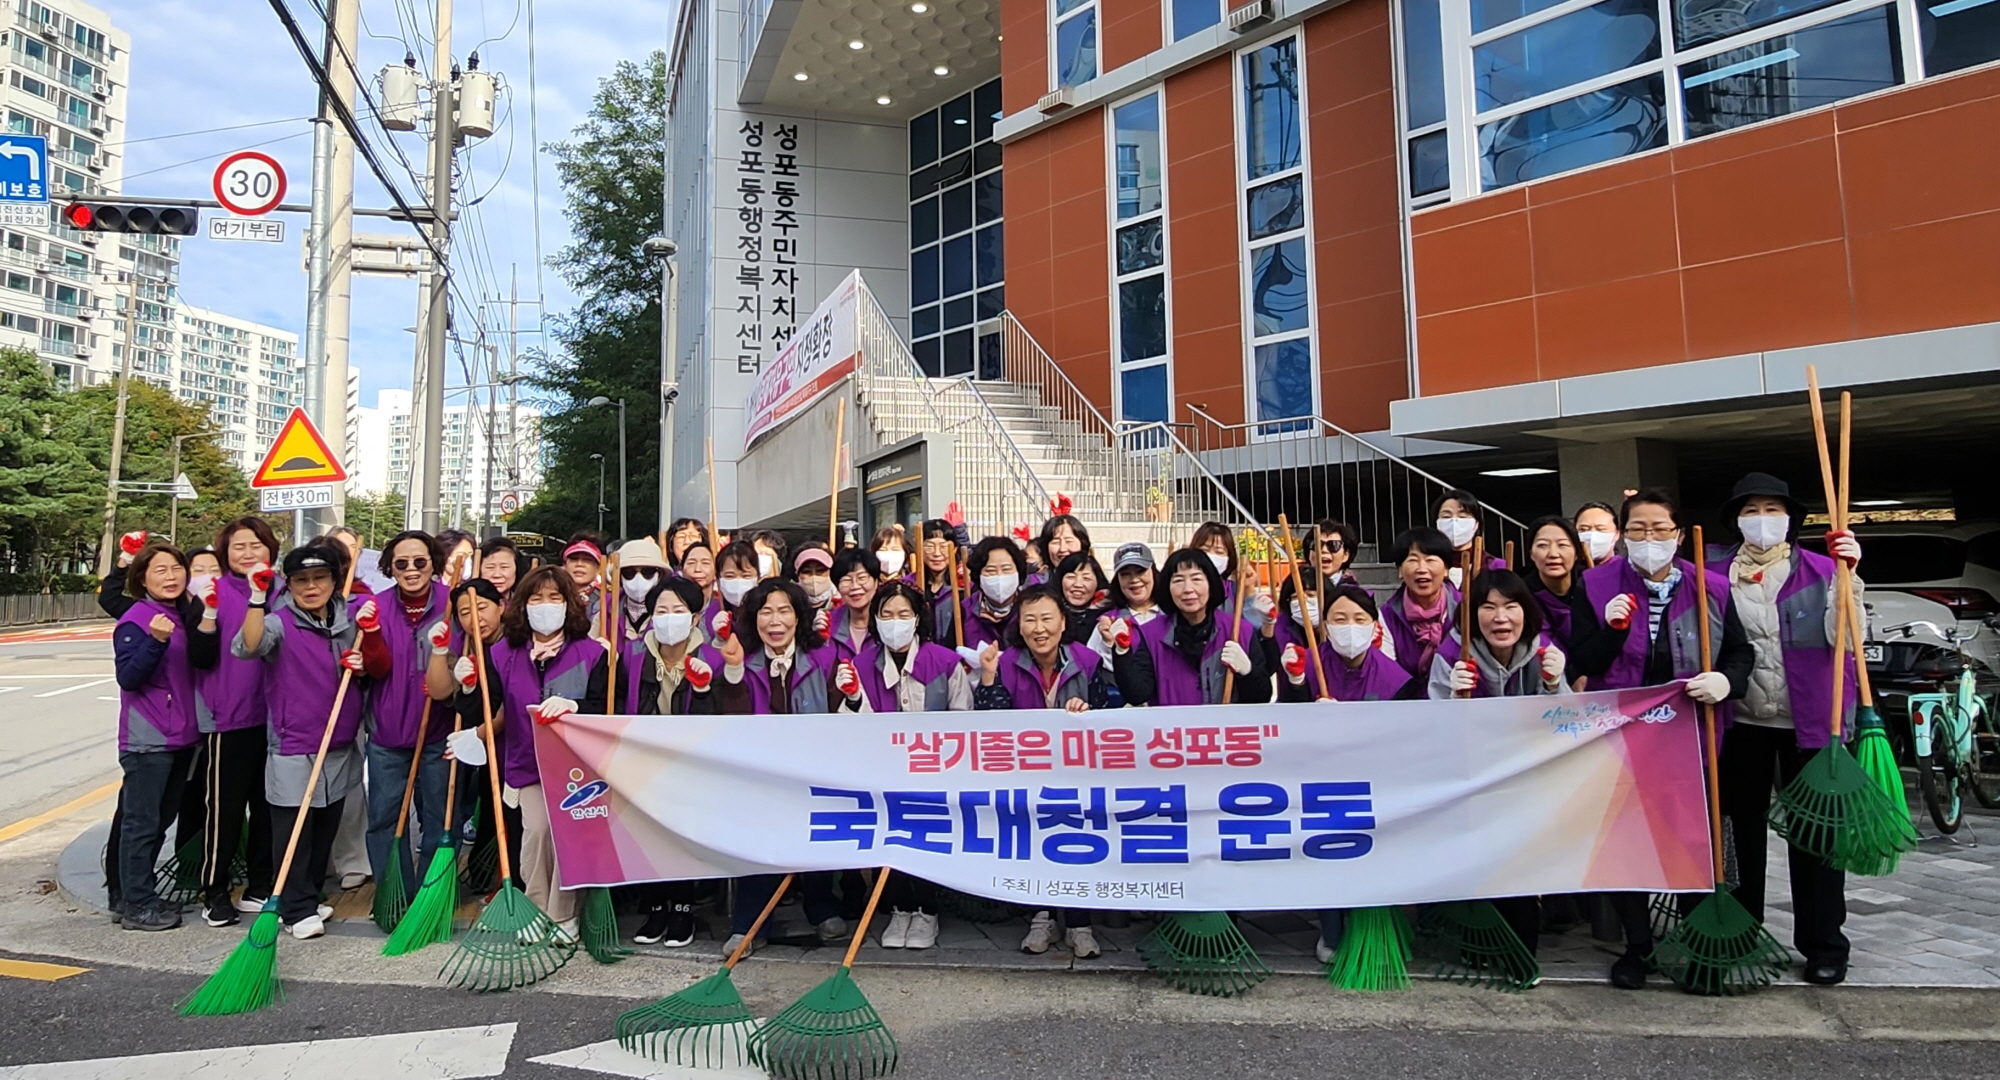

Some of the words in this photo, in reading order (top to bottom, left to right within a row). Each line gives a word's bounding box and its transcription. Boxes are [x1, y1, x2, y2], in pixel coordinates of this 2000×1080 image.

[229, 169, 272, 198] 30
[0, 205, 44, 215] 진신호시
[0, 215, 45, 224] 회전가능
[214, 221, 281, 239] 여기부터
[771, 123, 799, 351] 성포동주민자치센
[266, 489, 330, 506] 전방30m
[504, 501, 515, 510] 30
[1863, 647, 1880, 660] 53
[891, 730, 1053, 773] "살기좋은
[1062, 728, 1137, 770] 마을
[1146, 724, 1279, 769] 성포동"
[571, 805, 608, 820] 안산시
[809, 783, 1189, 865] 국토대청결
[1217, 781, 1376, 862] 운동
[1001, 878, 1031, 893] 주최
[1045, 880, 1091, 898] 성포동
[1095, 881, 1185, 899] 행정복지센터
